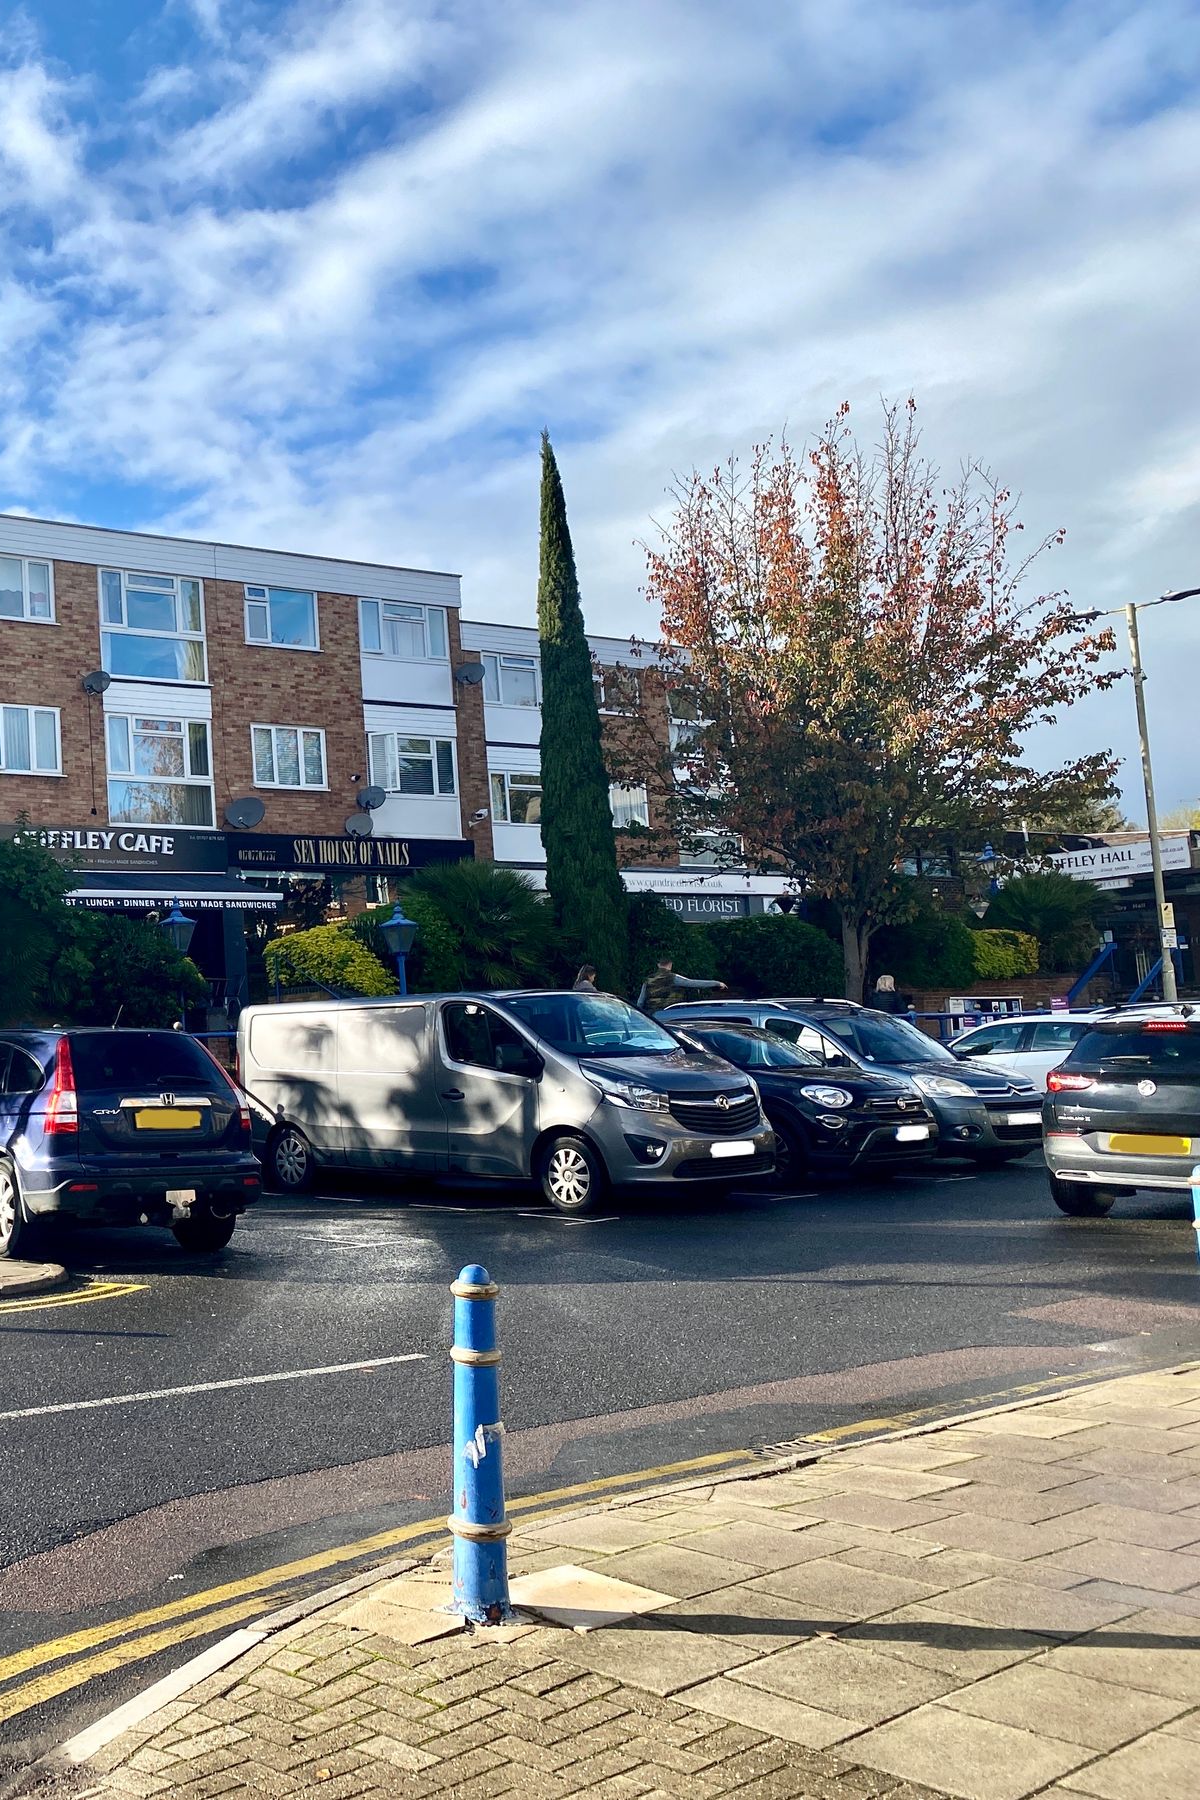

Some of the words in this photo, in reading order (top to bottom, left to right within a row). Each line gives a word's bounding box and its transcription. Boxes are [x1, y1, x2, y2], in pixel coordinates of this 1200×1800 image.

[118, 833, 175, 855] CAFE
[293, 839, 316, 864] SEN
[319, 840, 357, 865] HOUSE
[360, 841, 374, 866] OF
[377, 842, 410, 866] NAILS
[1101, 849, 1135, 865] HALL
[86, 898, 114, 907] LUNCH
[123, 899, 155, 908] DINNER
[164, 899, 198, 909] FRSHLY
[200, 900, 224, 909] MADE
[226, 900, 277, 910] SANDWICHES
[687, 898, 741, 913] FLORIST
